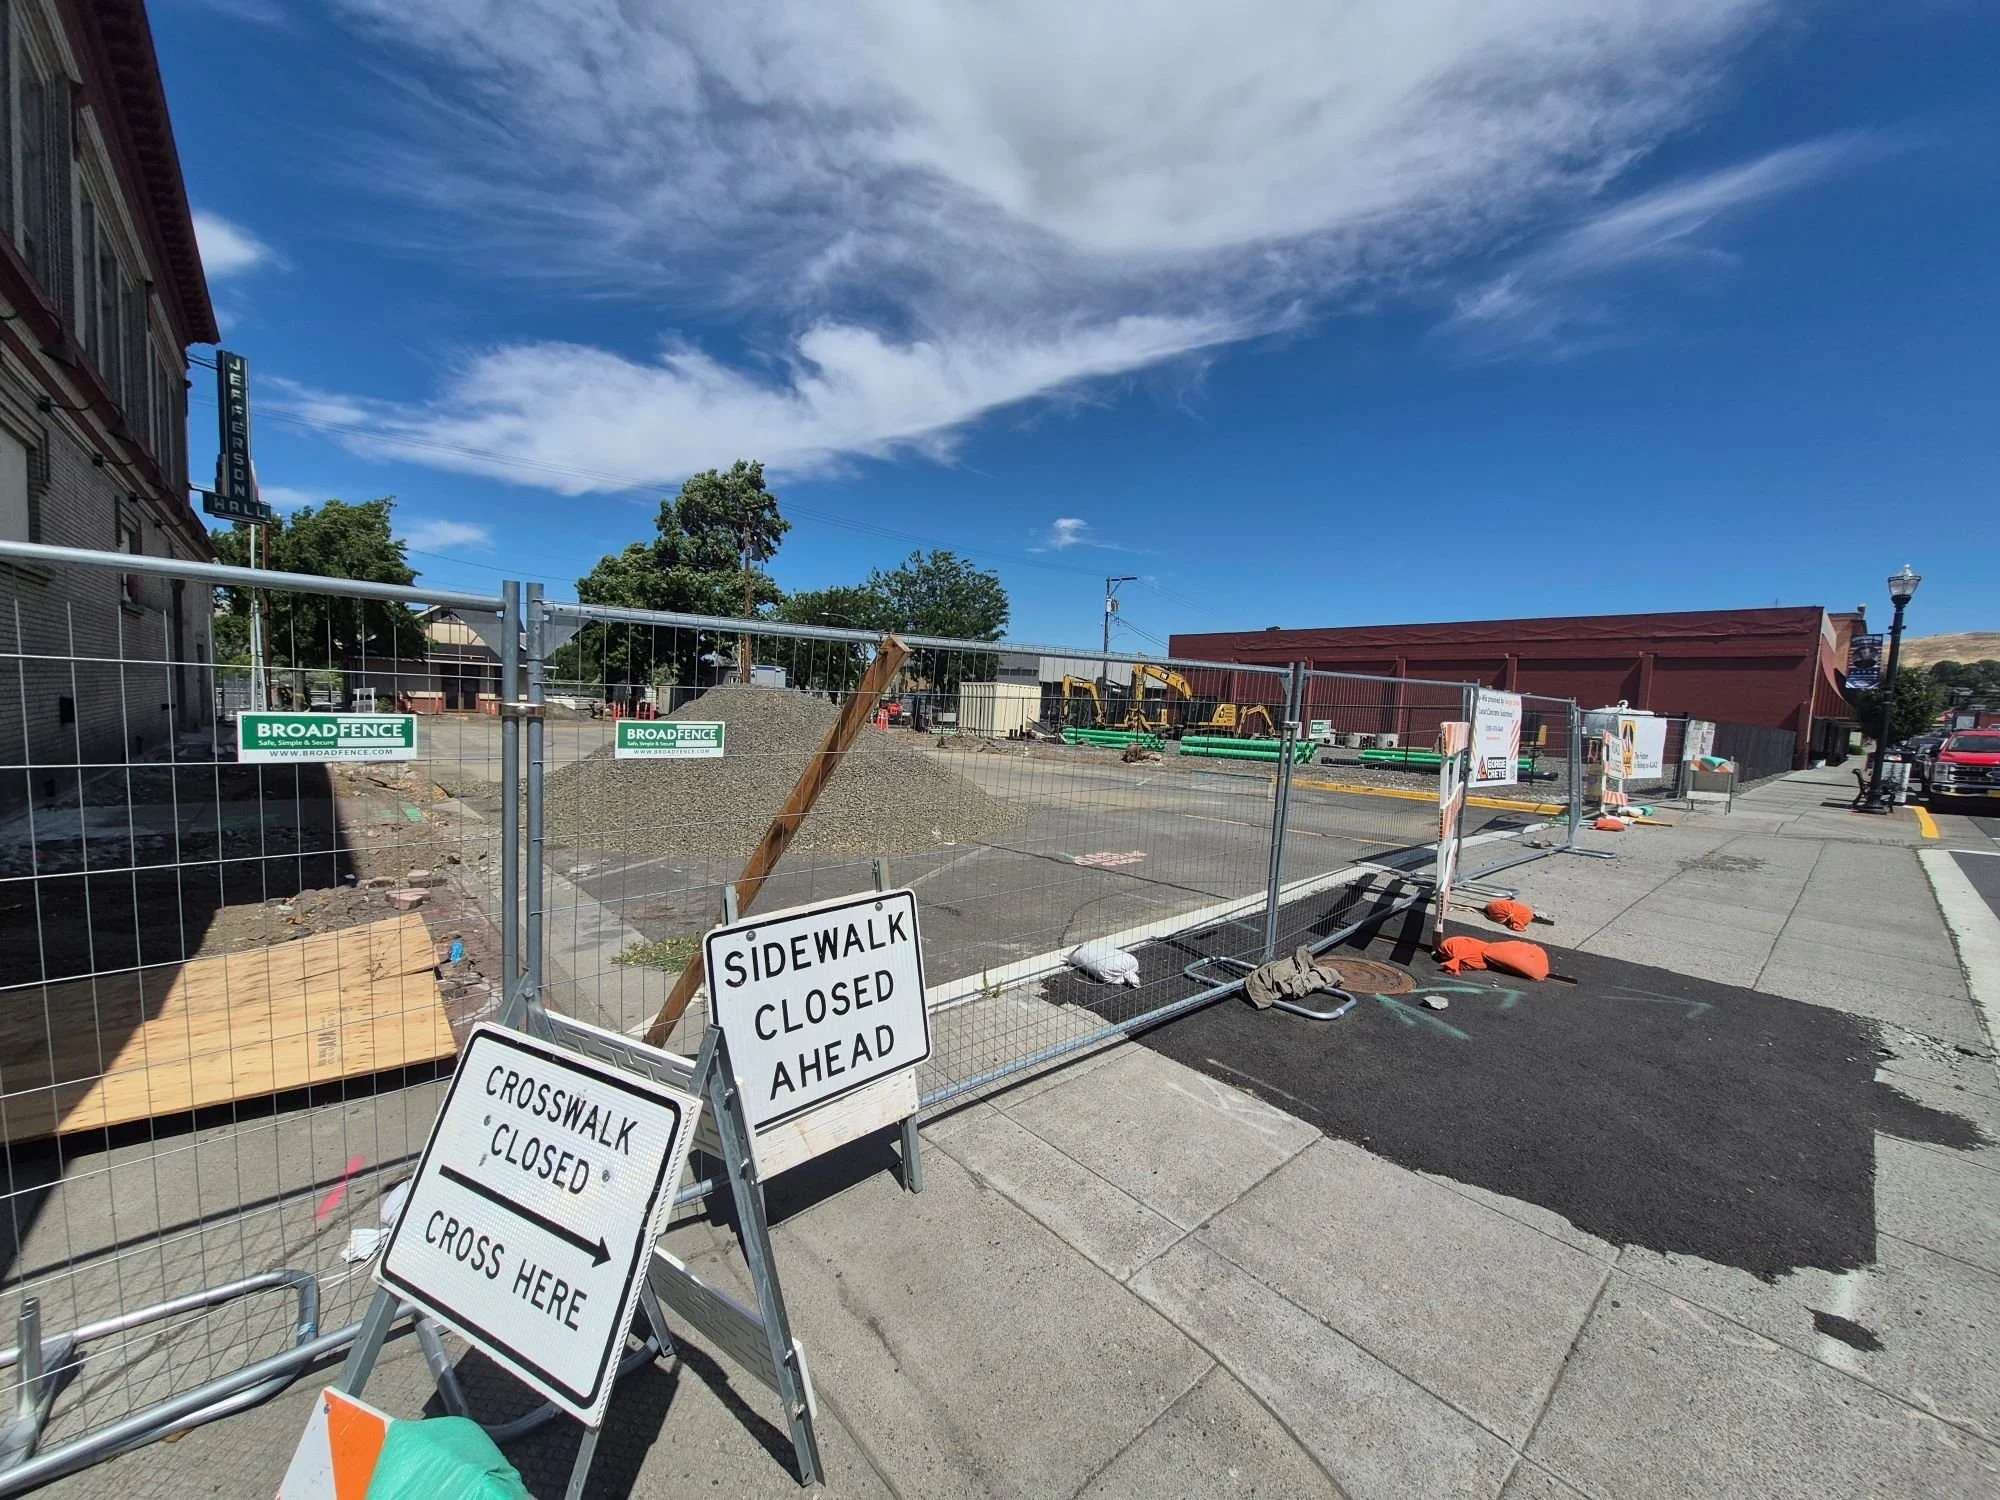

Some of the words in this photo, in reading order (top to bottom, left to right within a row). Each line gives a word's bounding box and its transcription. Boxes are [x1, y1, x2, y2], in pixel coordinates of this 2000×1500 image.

[229, 358, 246, 497] JEFFERSON
[214, 497, 267, 518] HALL
[257, 723, 403, 738] BROADFENCE
[258, 739, 277, 747] Safe,
[278, 739, 302, 747] Simple
[270, 749, 393, 757] WWW.BROADFENCE.COM
[627, 728, 716, 740] BROADFENCE
[1488, 759, 1506, 768] GORGE
[1488, 769, 1506, 779] CRETE
[724, 911, 908, 988] SIDEWALK
[755, 969, 894, 1041] CLOSED
[769, 1024, 894, 1101] AHEAD
[486, 1065, 638, 1155] CROSSWALK
[490, 1123, 590, 1195] CLOSED
[425, 1210, 505, 1280] CROSS
[512, 1258, 588, 1332] HERE
